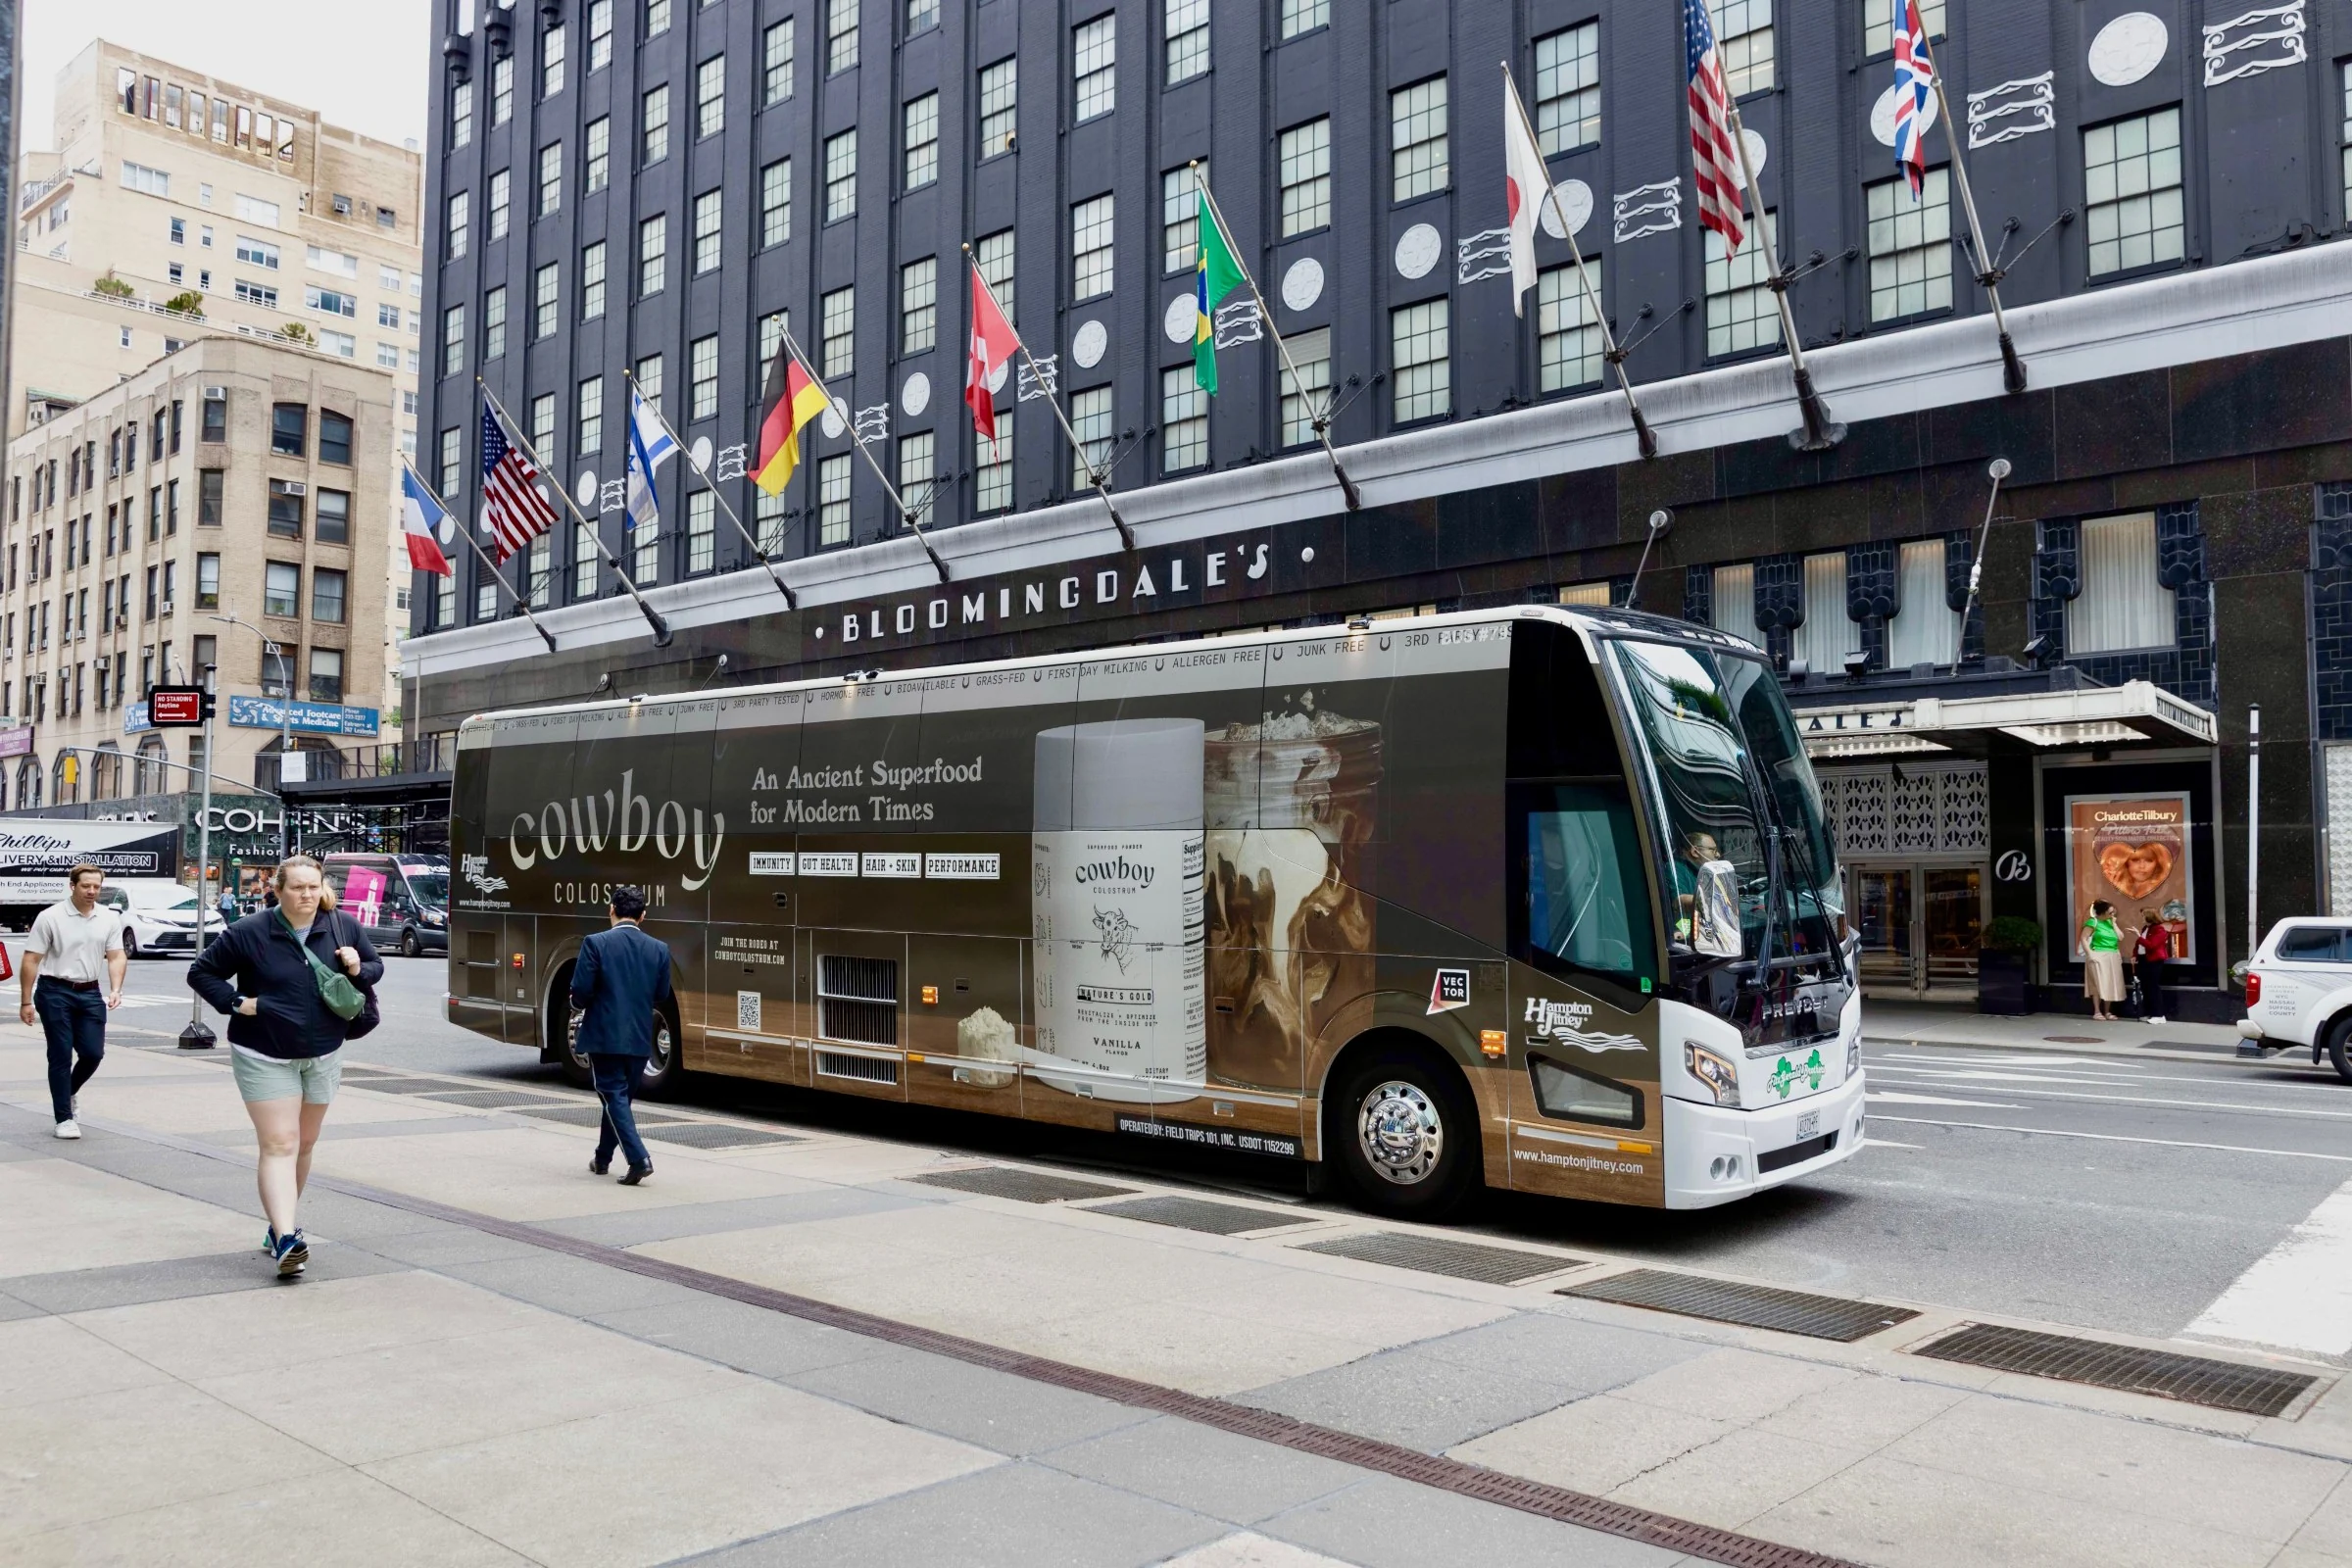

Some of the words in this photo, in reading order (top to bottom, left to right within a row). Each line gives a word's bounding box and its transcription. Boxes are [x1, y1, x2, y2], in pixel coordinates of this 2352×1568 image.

[843, 544, 1269, 643] BLOOMINGDALE'S
[648, 707, 663, 716] FREE
[679, 704, 696, 713] JUNK
[699, 702, 715, 711] FREE
[733, 699, 746, 709] 3RD
[749, 697, 770, 708] PARTY
[773, 695, 800, 705] TESTED
[820, 689, 853, 702] HORMONE
[857, 686, 876, 697] FREE
[897, 678, 956, 694] BIOAVAILABLE
[976, 672, 1026, 686] GRASS-FED
[1048, 666, 1077, 679] FIRST
[1080, 664, 1099, 677] DAY
[1103, 661, 1148, 674] MILKING
[1172, 653, 1226, 668] ALLERGEN
[1233, 650, 1261, 662] FREE
[1297, 644, 1326, 657] JUNK
[1334, 640, 1364, 654] FREE
[1404, 633, 1429, 647] 3RD
[273, 713, 299, 724] Sprts
[302, 717, 339, 727] Medicine
[307, 709, 342, 719] Footcare
[751, 766, 779, 791] An
[785, 763, 863, 790] Ancient
[870, 756, 983, 791] Superfood
[750, 800, 776, 824] for
[783, 798, 861, 823] Modern
[868, 796, 934, 821] Times
[510, 768, 725, 892] cowboy
[60, 854, 152, 866] INSTALLATION
[753, 857, 791, 870] IMMUNITY
[802, 857, 818, 870] GUT
[820, 857, 854, 871] HEALTH
[865, 858, 887, 872] HAIR
[896, 858, 917, 872] SKIN
[928, 858, 998, 874] PERFORMANCE
[1075, 855, 1154, 889] cowboy
[24, 880, 65, 890] Appliances
[555, 882, 665, 907] COLOSUM
[720, 937, 734, 947] JOIN
[735, 938, 747, 948] THE
[749, 939, 767, 950] RODEO
[769, 940, 779, 950] AT
[715, 950, 785, 965] COWBOYCOLOSTRUM.COM
[1443, 977, 1464, 987] VEC
[1081, 988, 1124, 1001] NATURE'S
[1129, 992, 1152, 1001] GOLD
[1443, 987, 1464, 998] TOR
[1524, 998, 1592, 1022] Hampton
[1537, 1010, 1583, 1036] Jitney
[1093, 1037, 1141, 1049] VANILLA
[1119, 1118, 1152, 1135] OPERATED
[1153, 1123, 1165, 1137] BY:
[1165, 1125, 1184, 1140] FIELD
[1185, 1128, 1205, 1143] TRIPS
[1205, 1132, 1220, 1147] 101,
[1221, 1134, 1237, 1147] INC.
[1239, 1137, 1262, 1151] USDOT
[1263, 1140, 1295, 1155] 1152299
[1514, 1149, 1643, 1174] www.hamptonjitney.com
